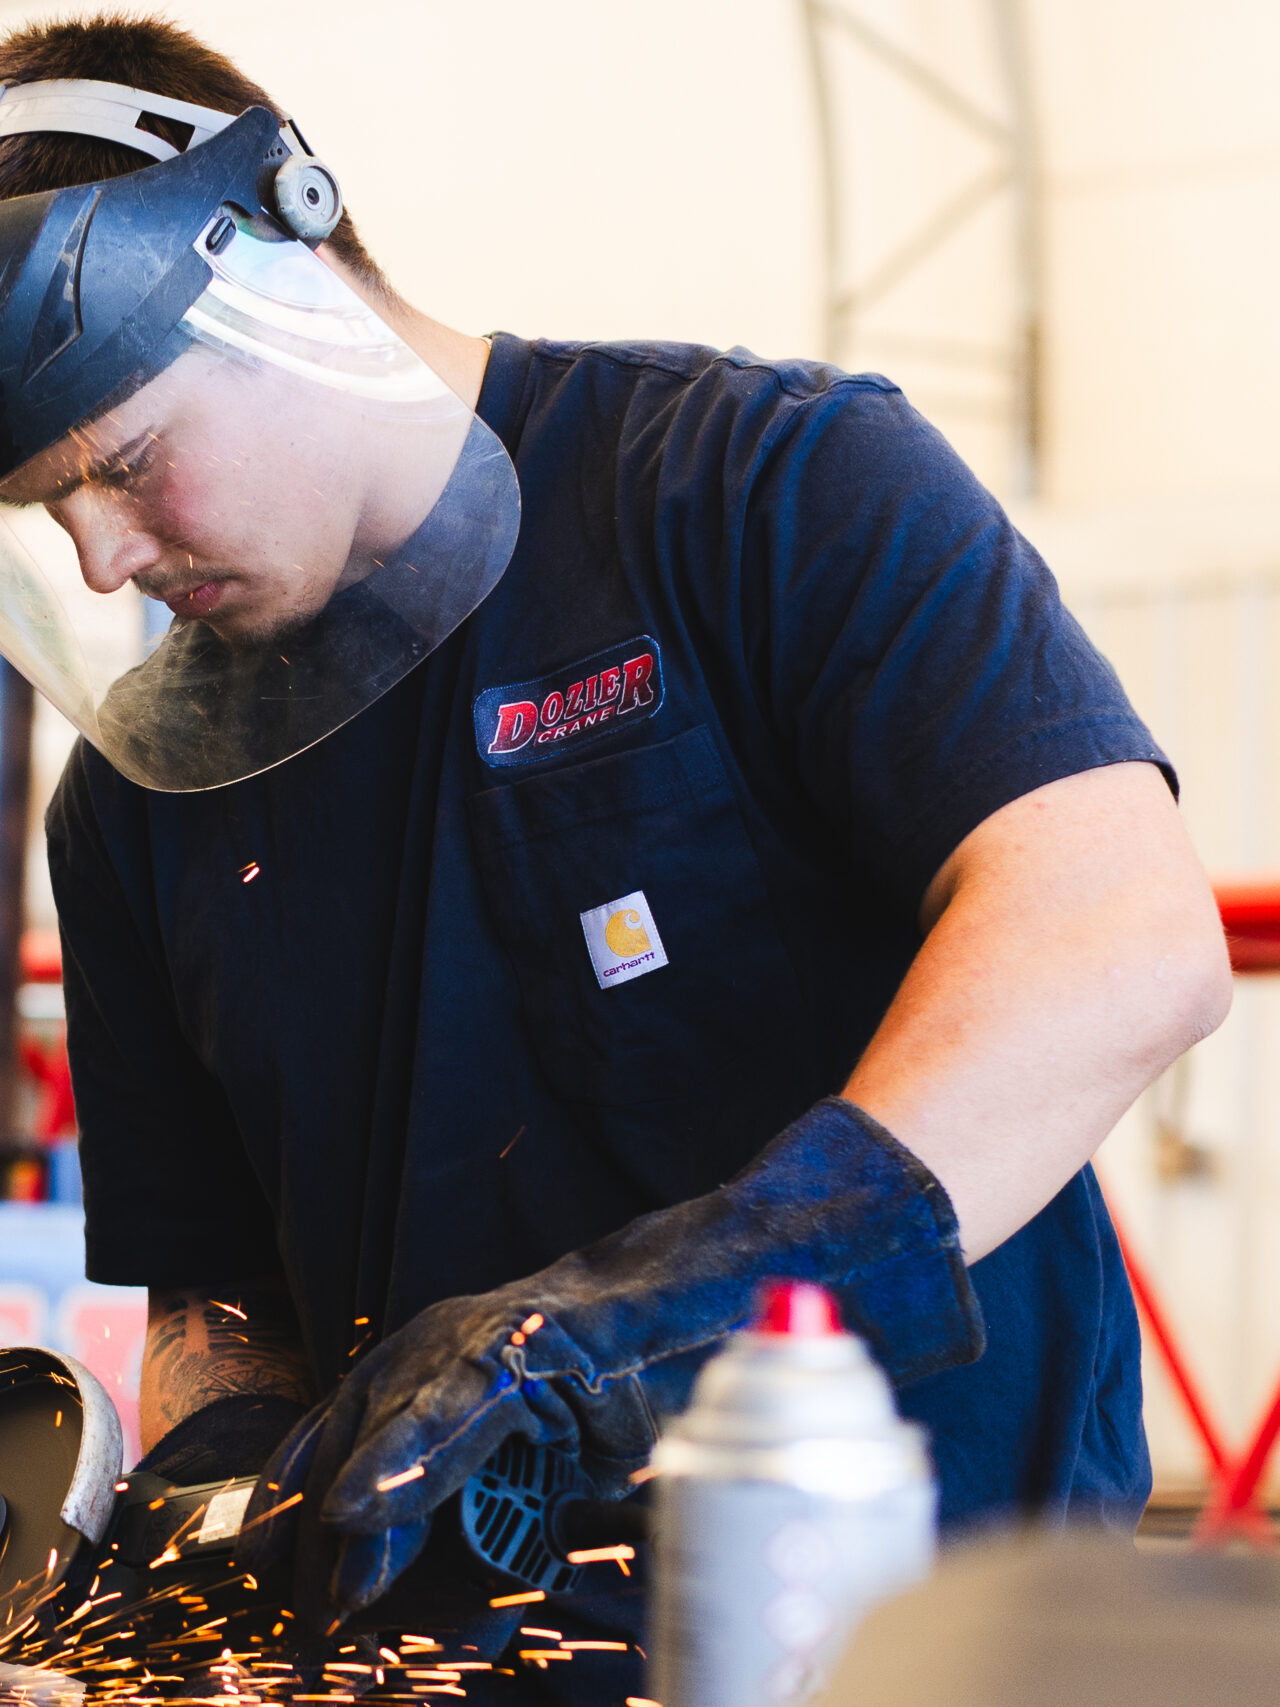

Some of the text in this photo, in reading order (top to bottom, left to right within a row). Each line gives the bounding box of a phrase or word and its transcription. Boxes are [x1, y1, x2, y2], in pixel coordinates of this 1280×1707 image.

[487, 653, 654, 754] DOZIER
[537, 710, 615, 744] CRANE
[603, 951, 655, 977] carhartt
